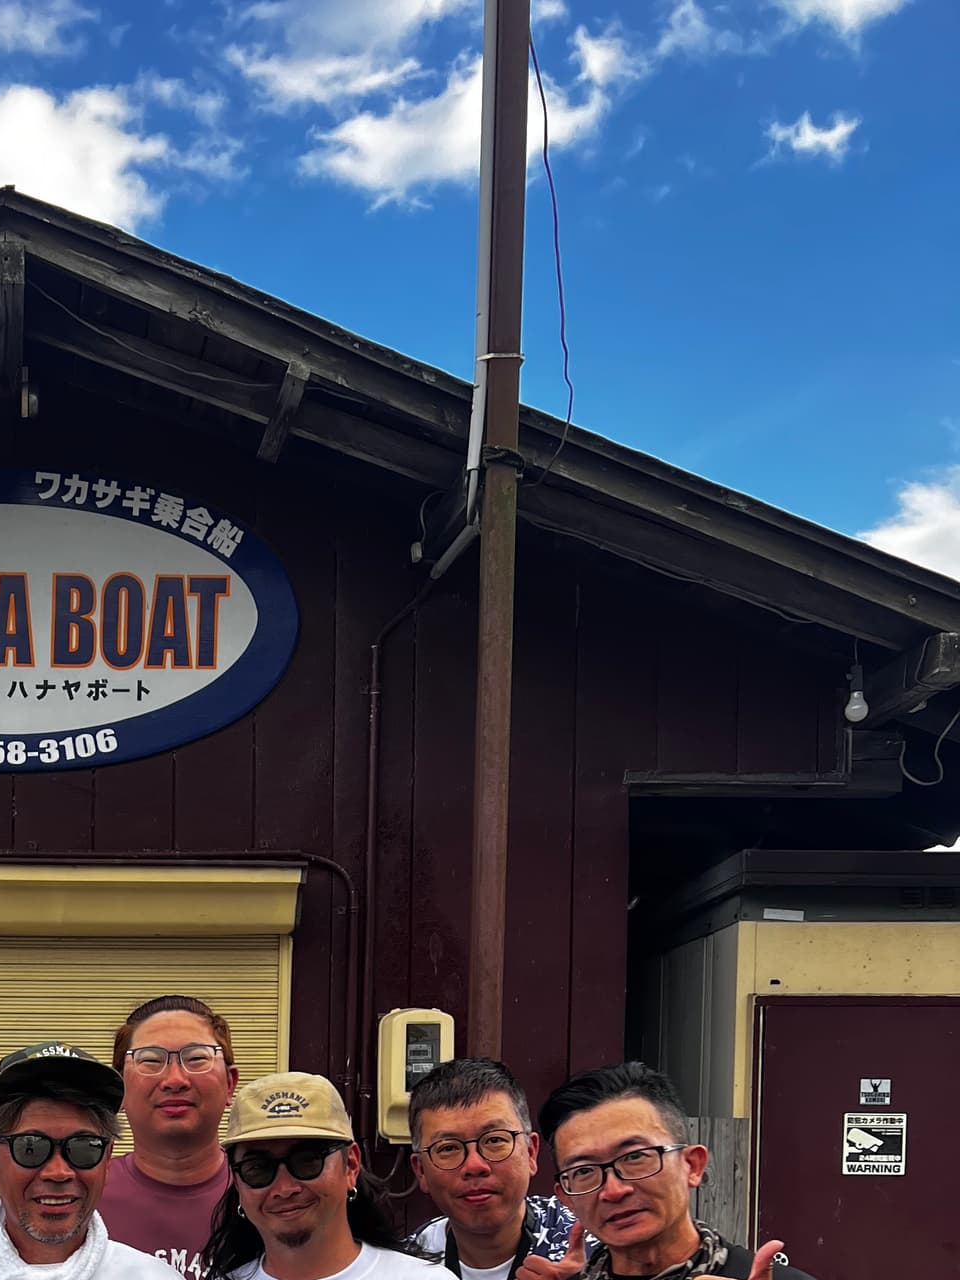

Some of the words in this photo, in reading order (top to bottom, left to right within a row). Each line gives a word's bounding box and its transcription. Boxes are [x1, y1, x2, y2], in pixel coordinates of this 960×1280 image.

[34, 471, 244, 558] ワカサギ乗合船
[50, 571, 231, 670] BOAT
[7, 679, 151, 701] ハナヤボート
[847, 1164, 901, 1173] WARNING
